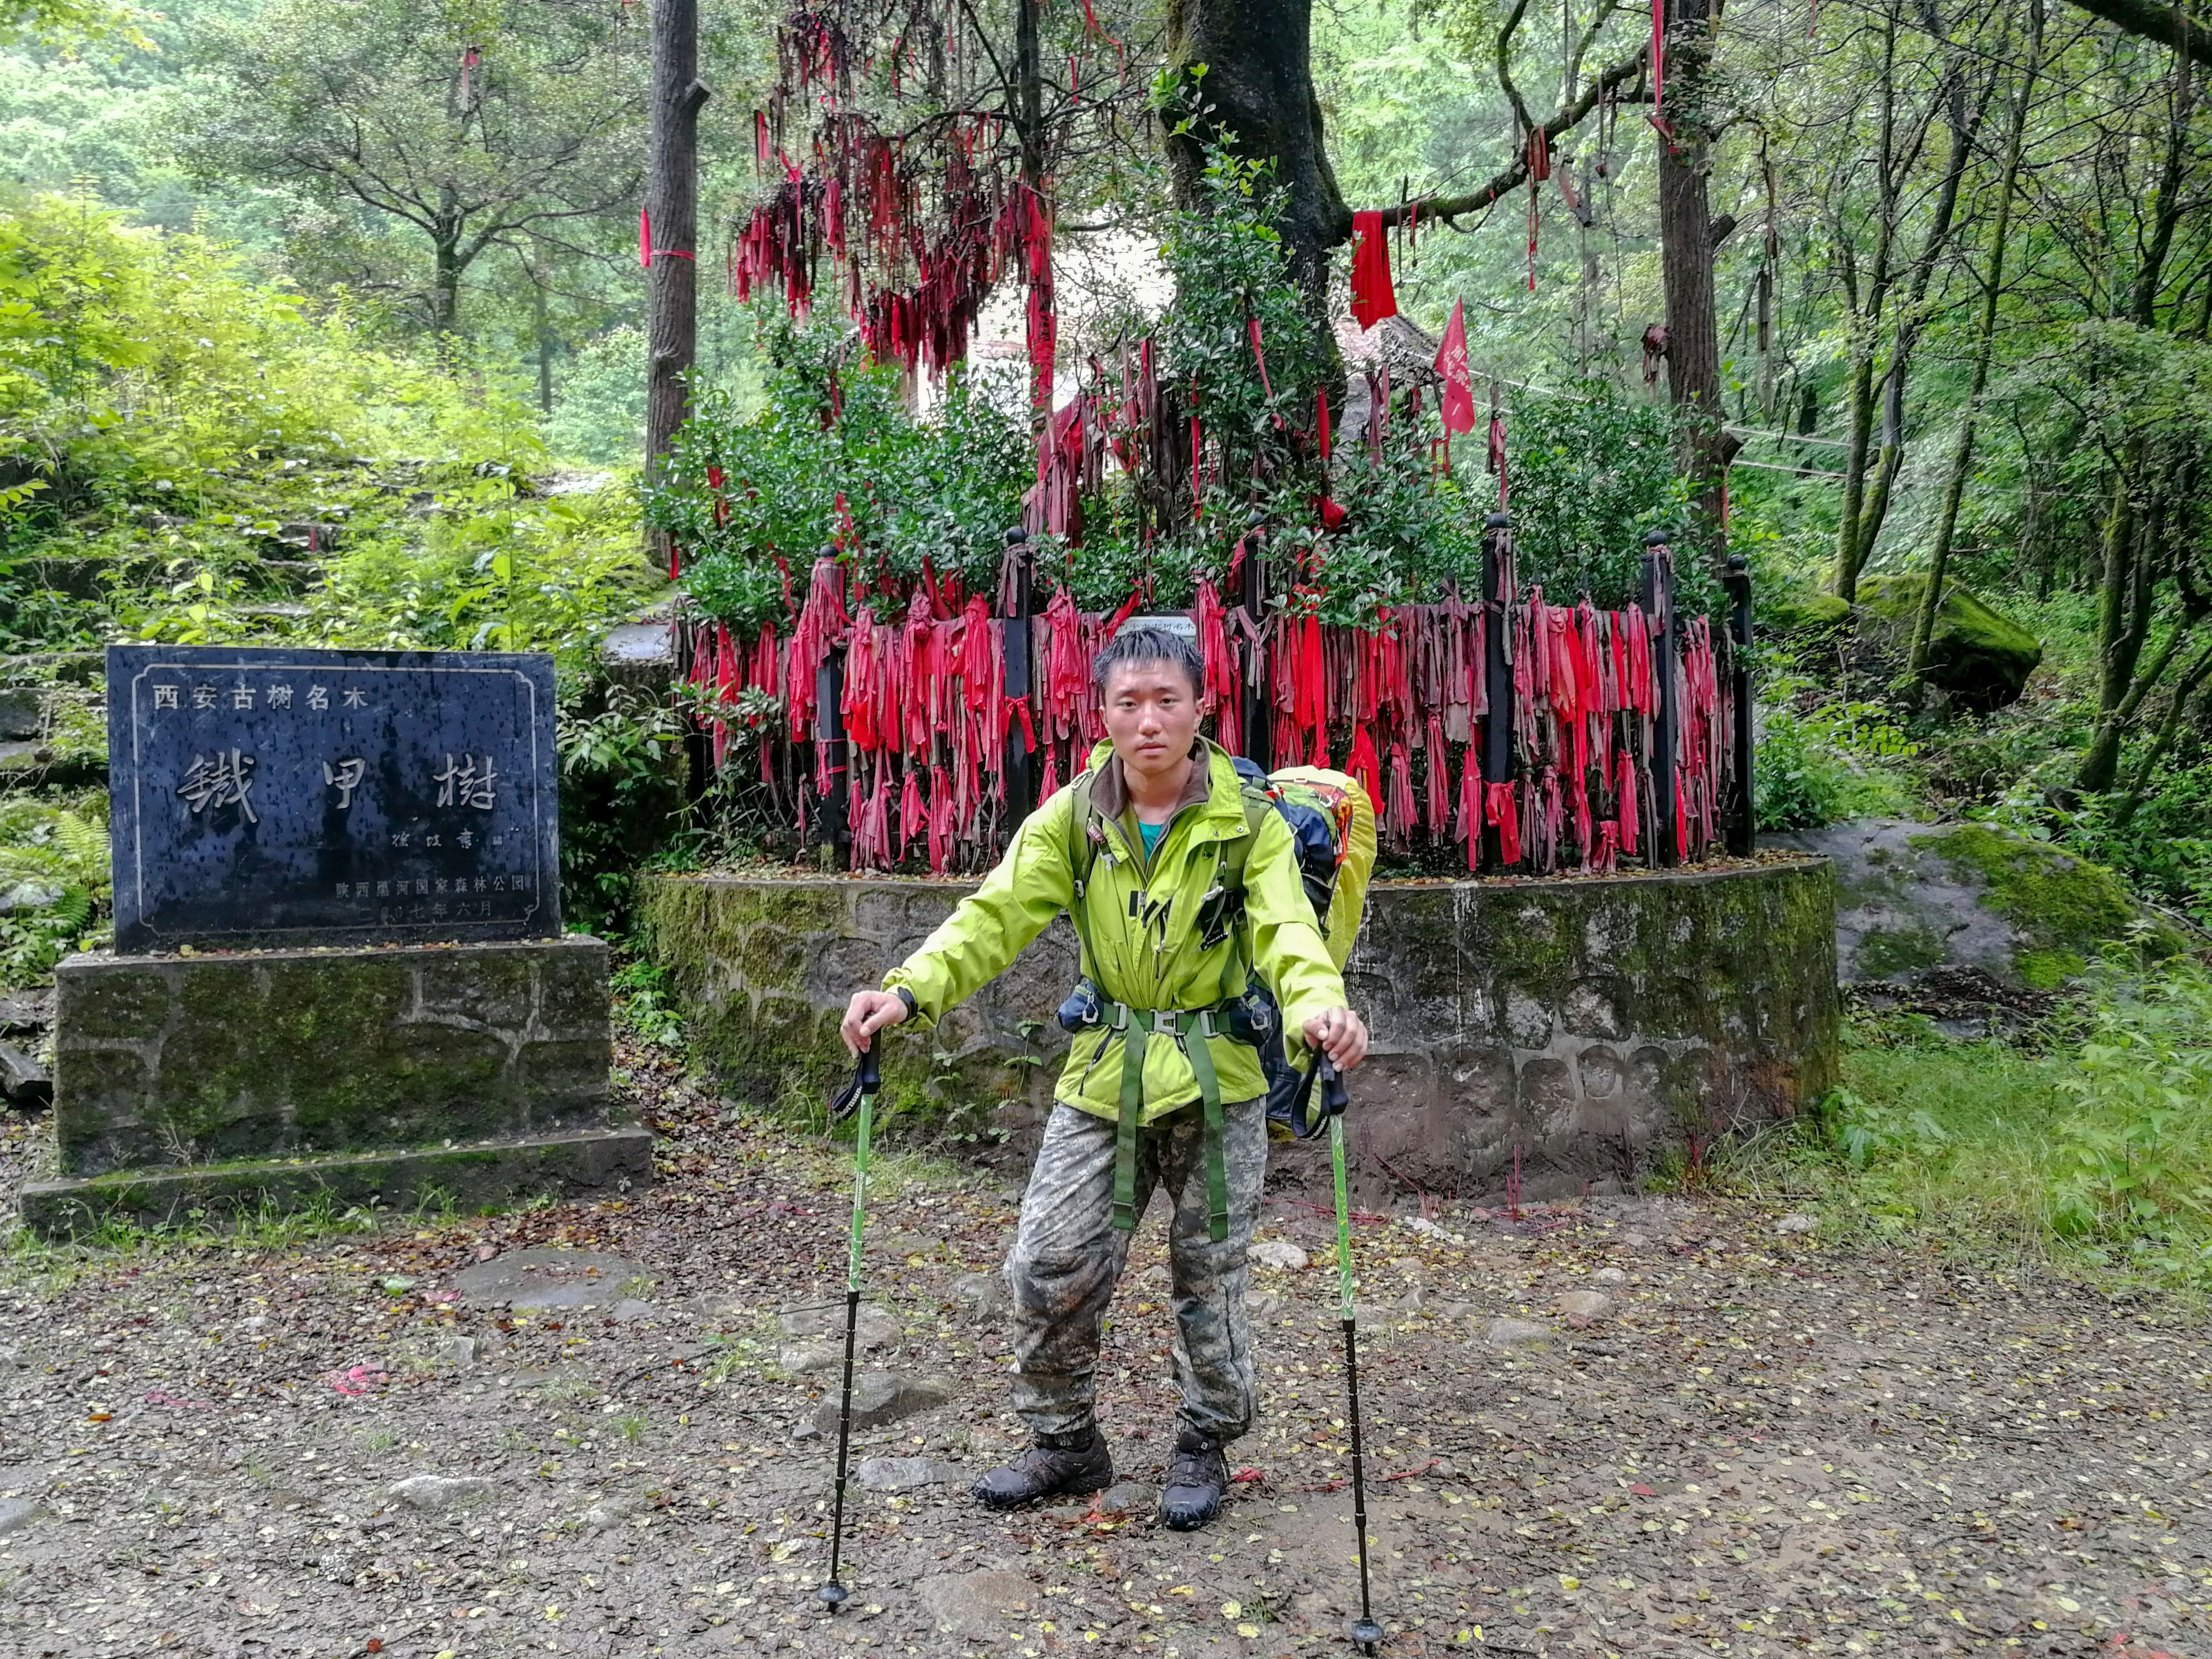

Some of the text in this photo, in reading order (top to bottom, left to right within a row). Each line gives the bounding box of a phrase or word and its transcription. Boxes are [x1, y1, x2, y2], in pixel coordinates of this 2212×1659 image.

[153, 684, 368, 710] 西安古树名木
[336, 875, 523, 899] 陕西黑河国家森林公园
